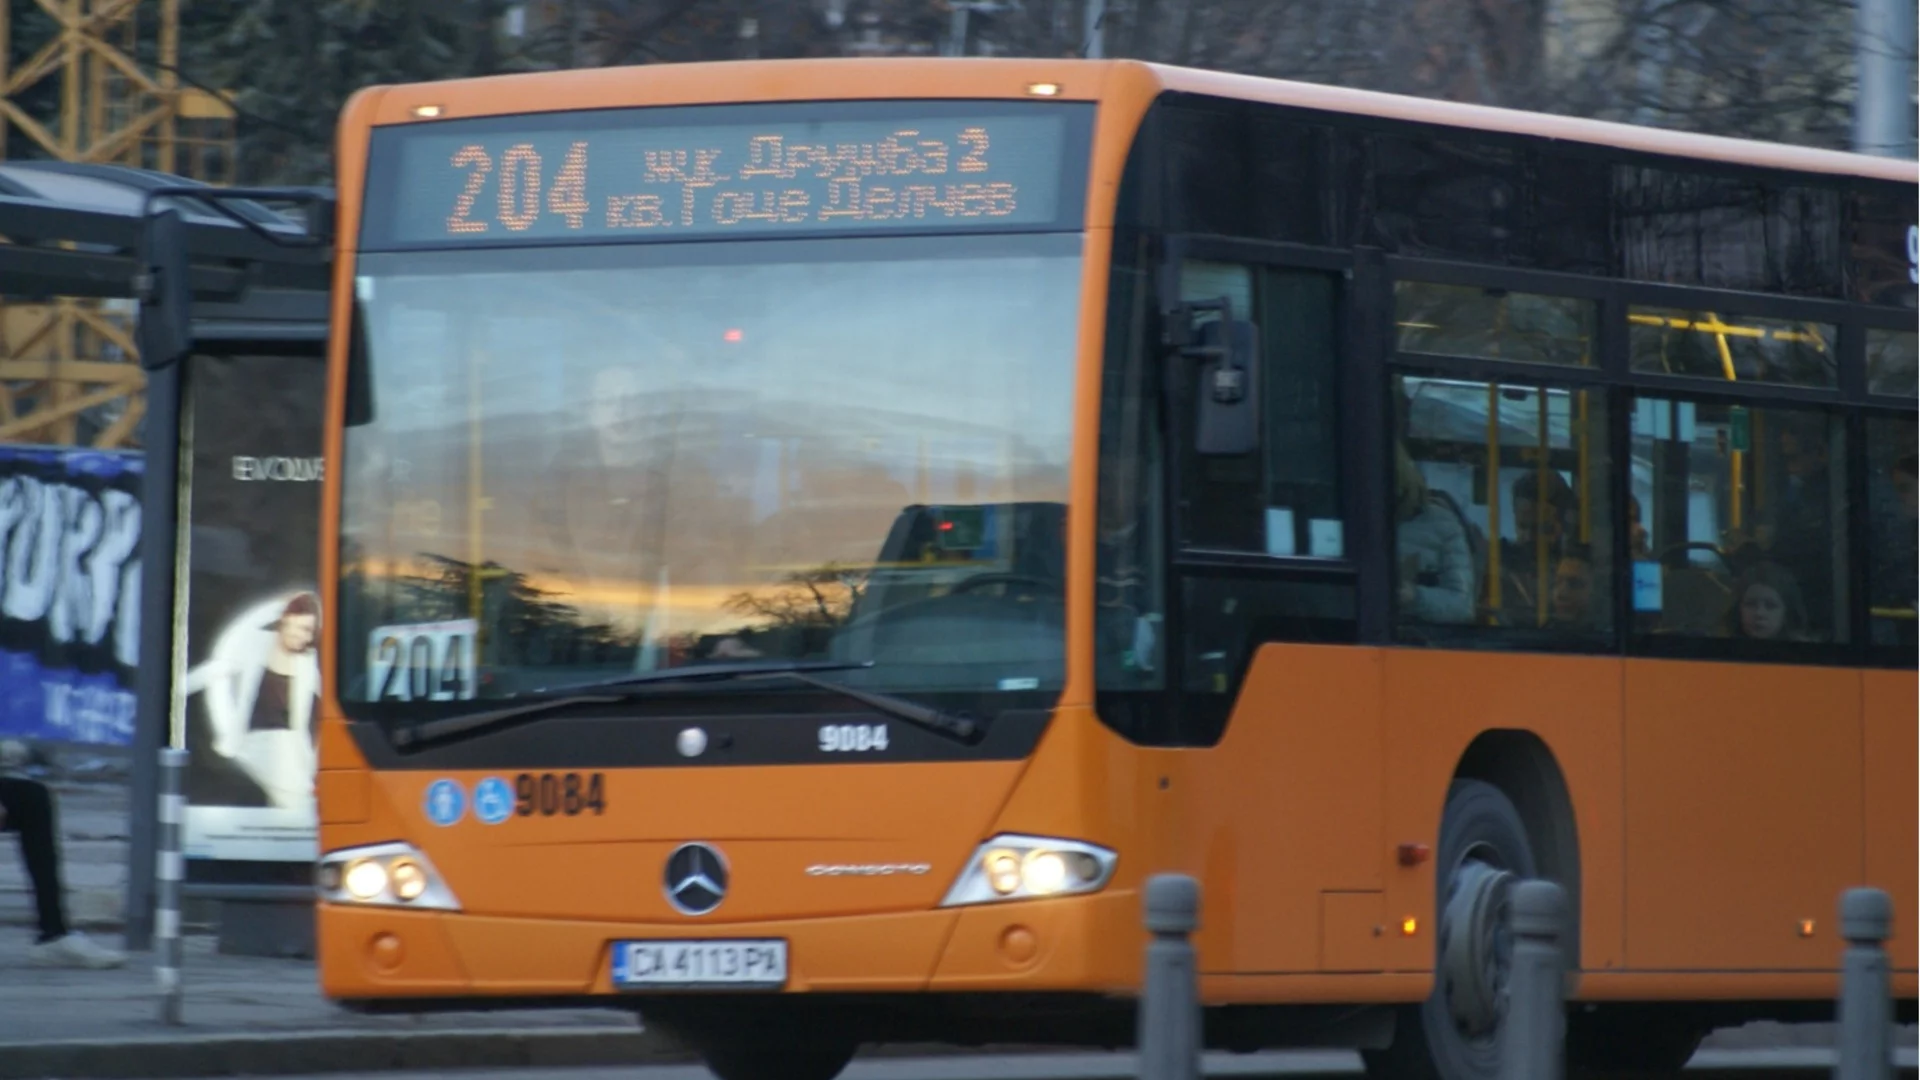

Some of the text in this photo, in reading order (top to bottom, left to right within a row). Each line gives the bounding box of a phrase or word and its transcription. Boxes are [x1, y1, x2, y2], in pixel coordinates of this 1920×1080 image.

[739, 128, 950, 180] Дружба
[956, 127, 990, 173] 2
[447, 141, 590, 233] 204
[817, 176, 1018, 222] Делчев
[378, 634, 467, 702] 204
[817, 723, 890, 752] 9084
[515, 772, 606, 817] 9084
[672, 947, 739, 978] 4113
